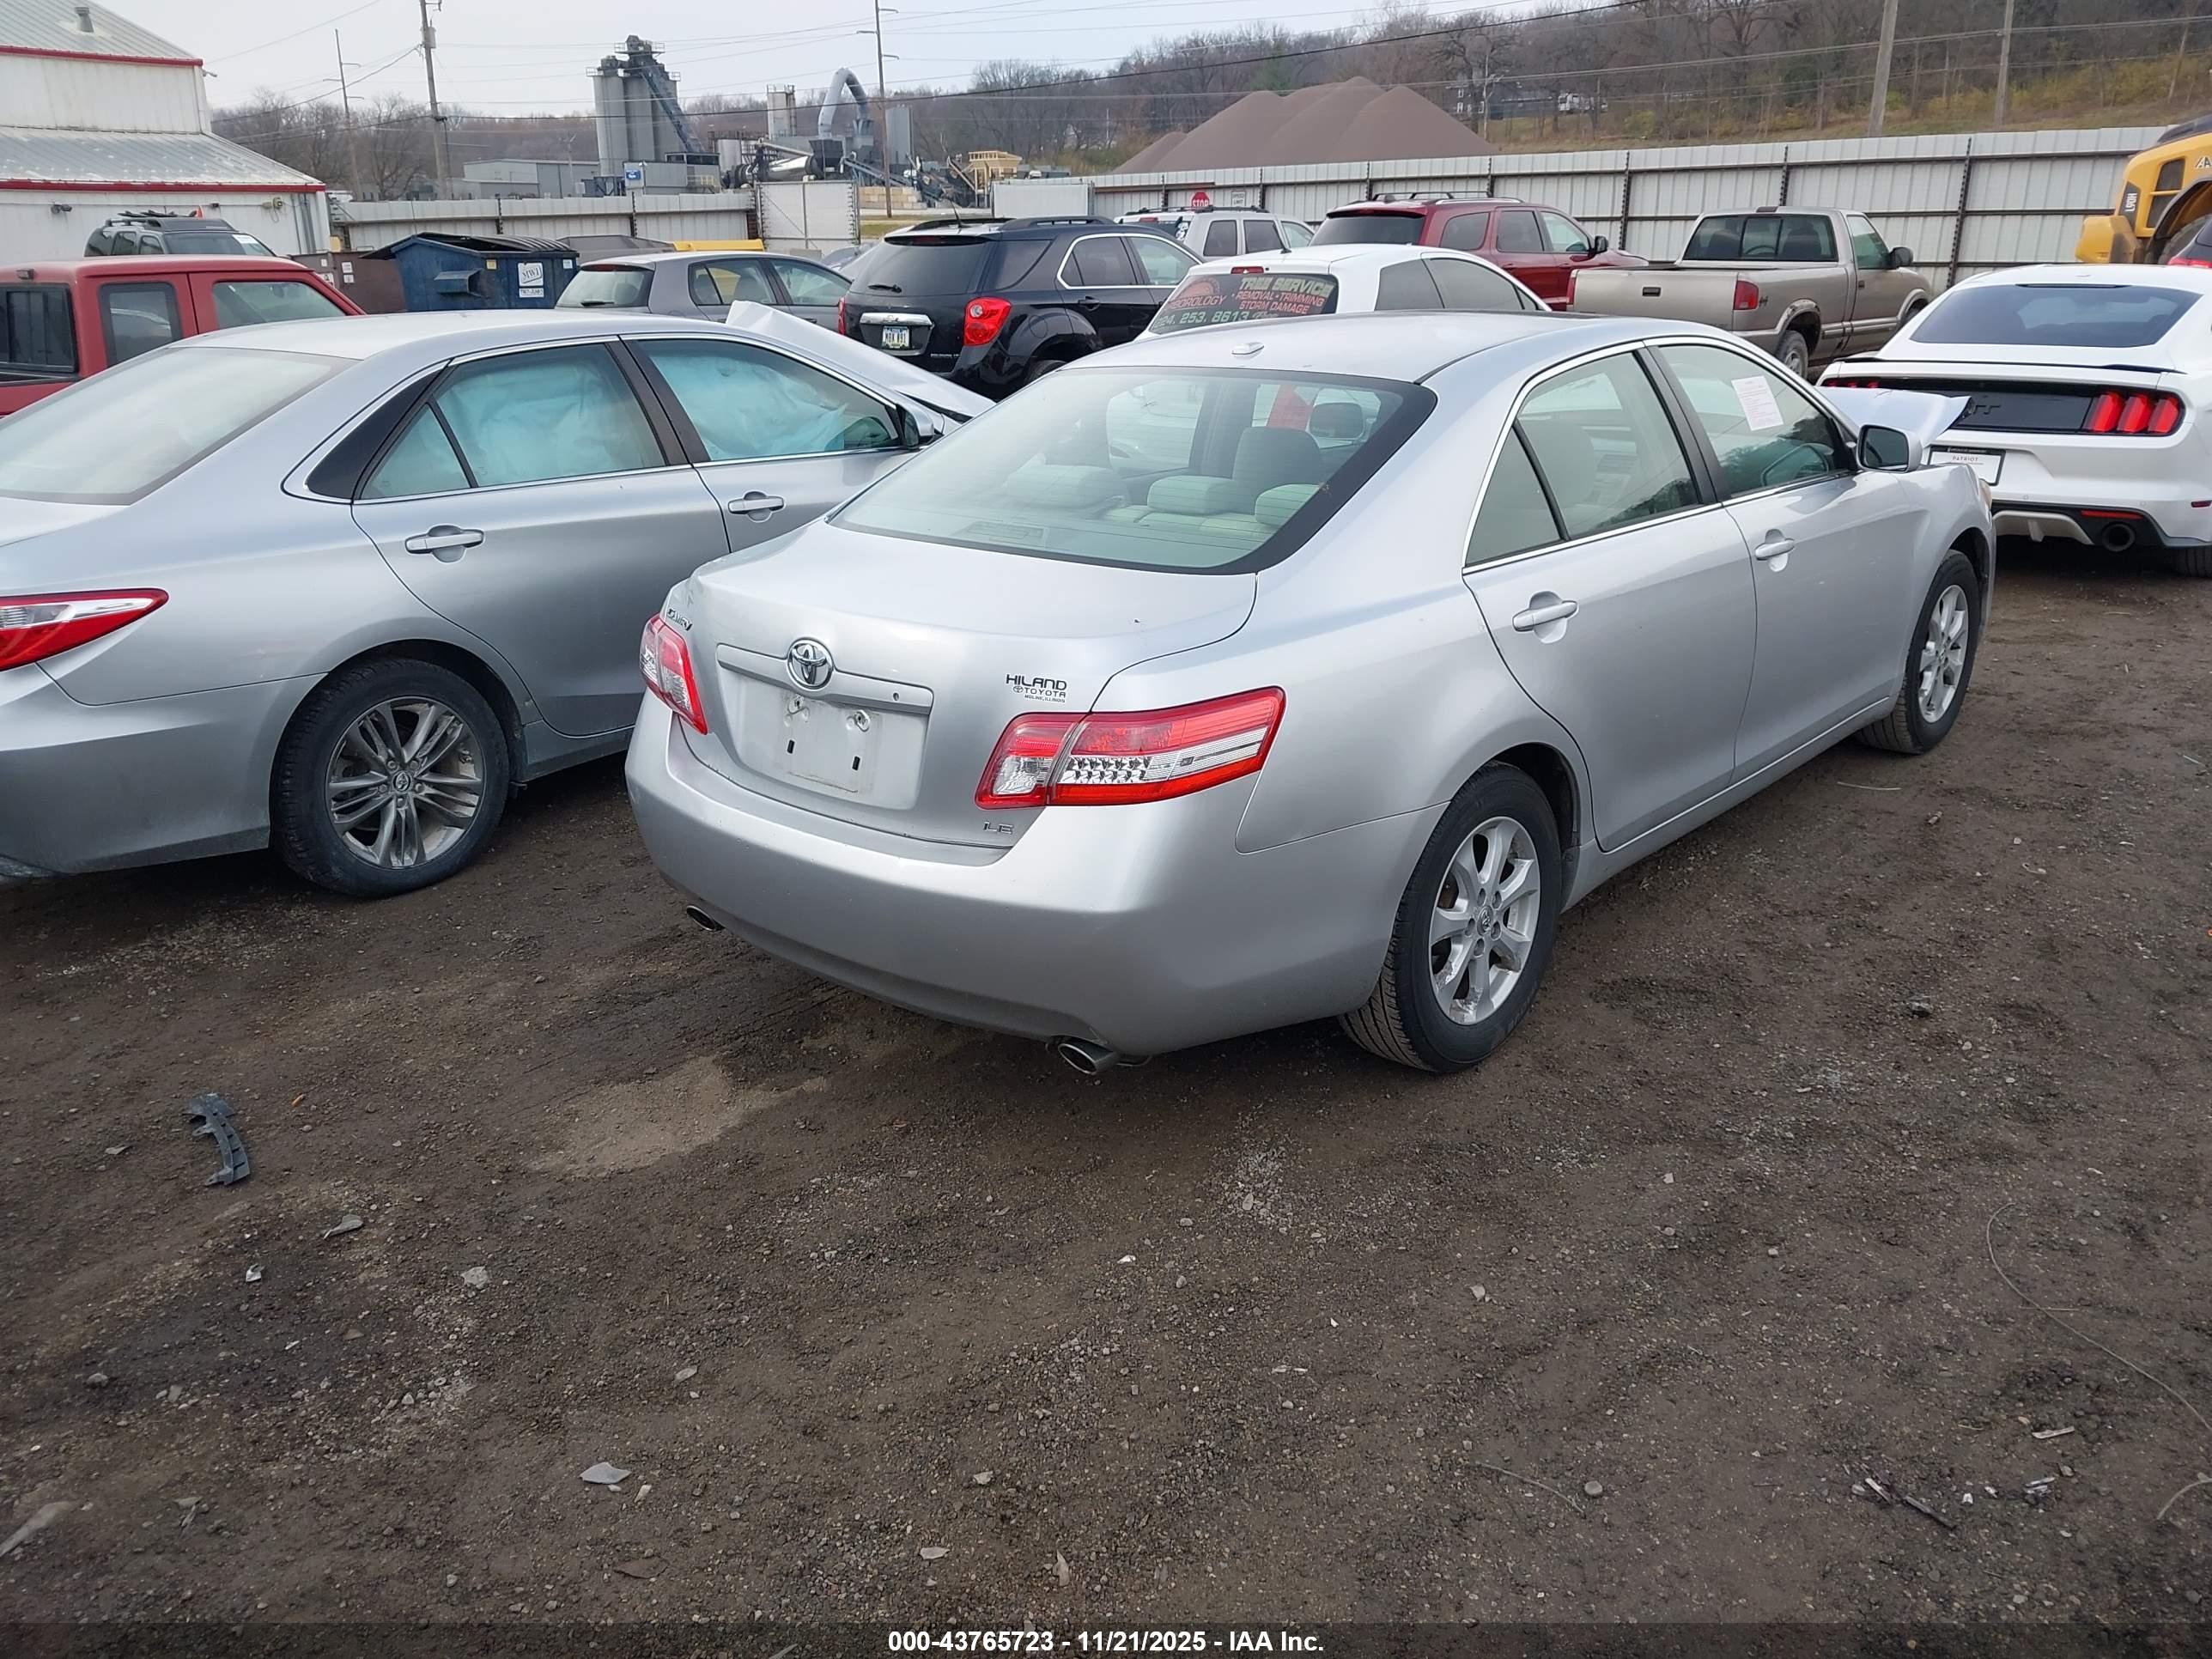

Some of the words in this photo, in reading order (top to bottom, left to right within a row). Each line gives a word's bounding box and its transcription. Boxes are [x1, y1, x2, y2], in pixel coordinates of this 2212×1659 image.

[1236, 291, 1274, 301] REMOVAL
[1279, 293, 1325, 307] TRIMMING
[1239, 301, 1269, 309] STORM
[1271, 301, 1310, 314] DAMAGE
[1006, 673, 1067, 690] HILAND
[1024, 687, 1066, 698] TOYOTA
[983, 821, 1013, 834] LE
